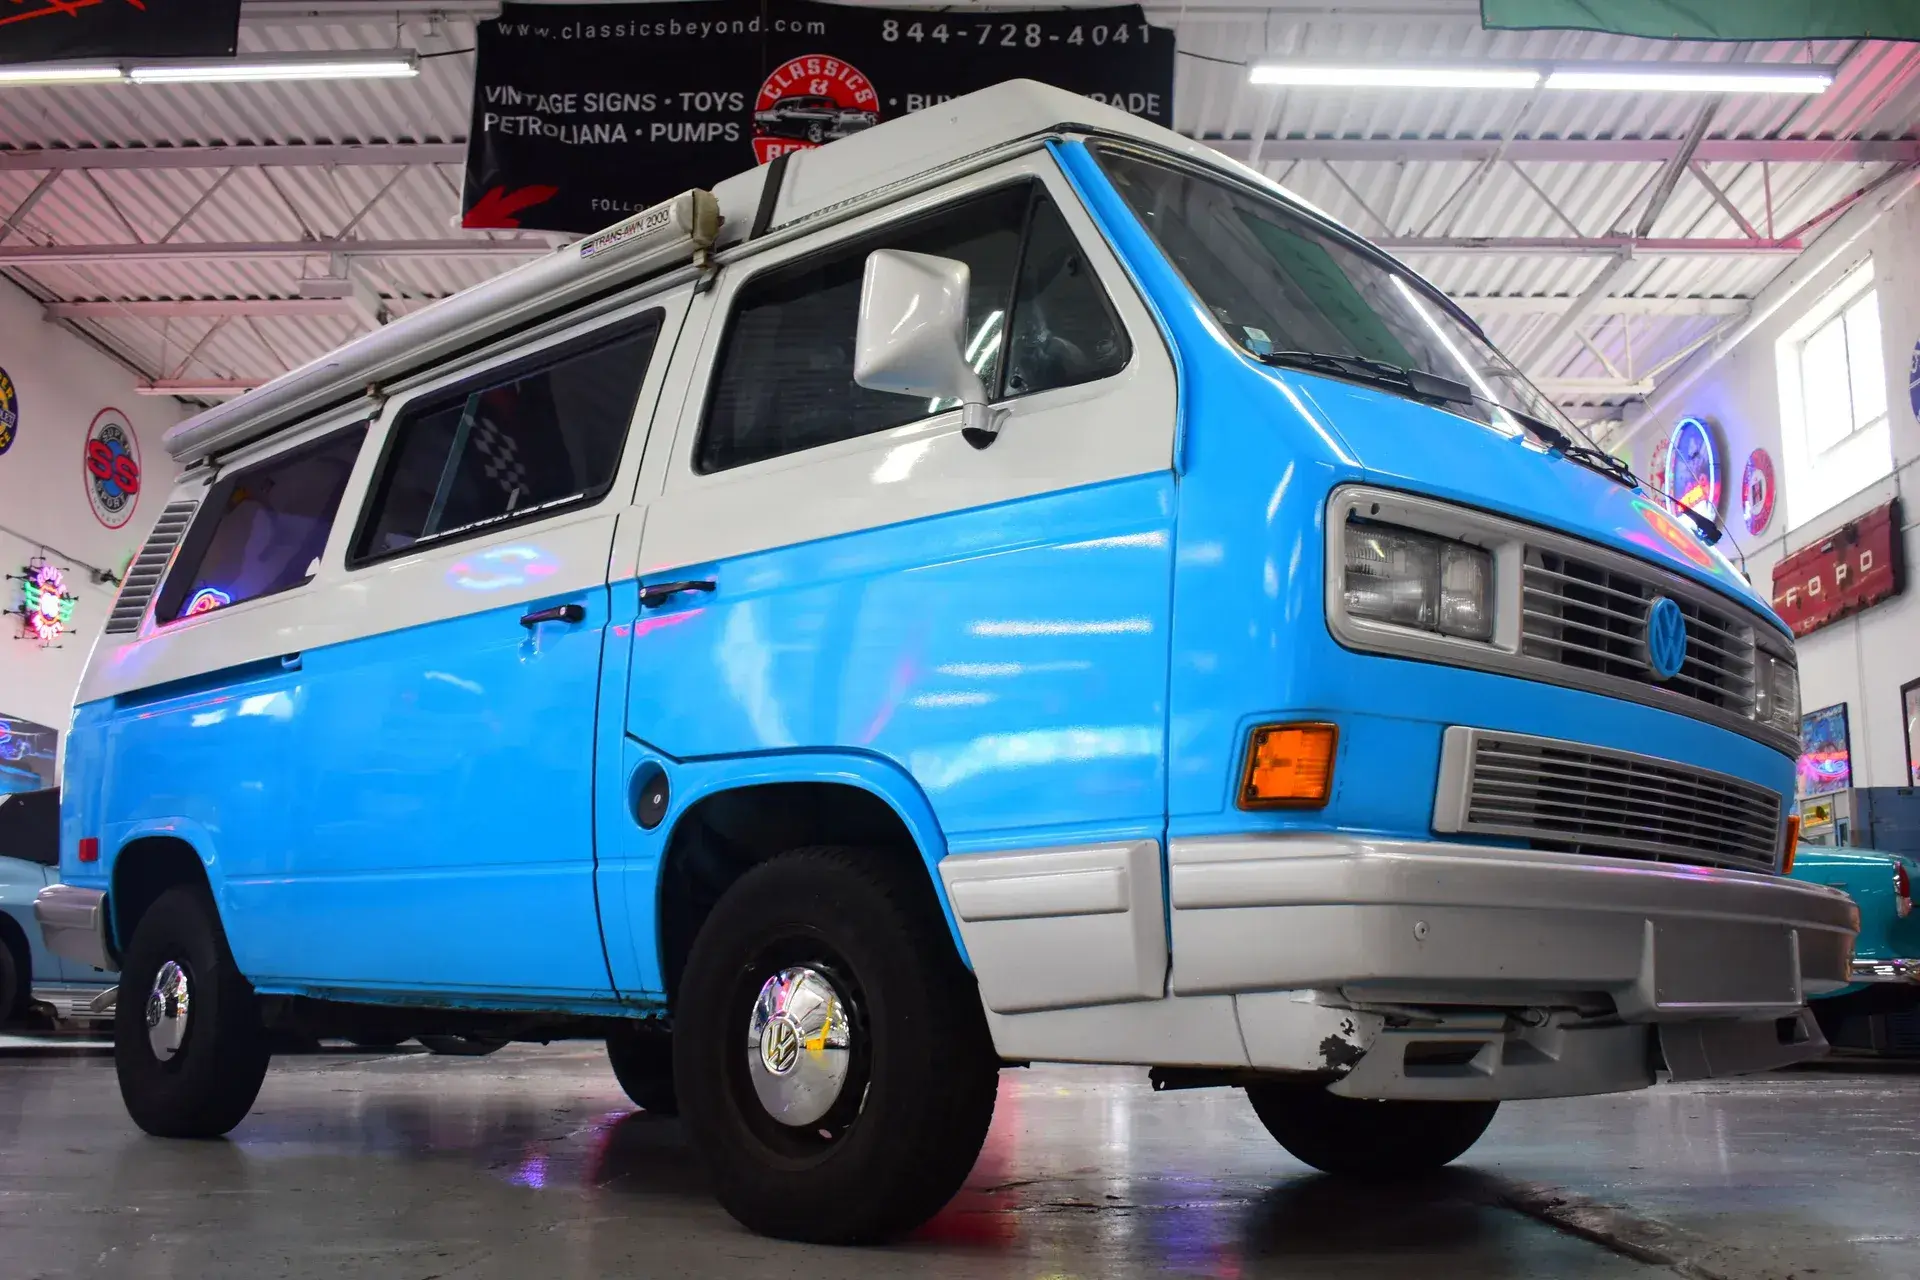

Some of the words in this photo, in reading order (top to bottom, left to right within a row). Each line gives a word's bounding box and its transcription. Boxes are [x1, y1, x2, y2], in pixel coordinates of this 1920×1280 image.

[498, 17, 826, 41] www.classicsbeyond.com
[882, 19, 1151, 47] 844-728-4041
[764, 58, 874, 104] CLASSICS
[808, 78, 829, 96] &
[485, 85, 577, 115] VINTAGE
[583, 92, 657, 113] SIGNS
[678, 91, 744, 112] TOYS
[484, 112, 628, 144] PETROLIANA
[650, 123, 740, 143] PUMPS
[590, 198, 651, 213] FOLLO
[645, 209, 669, 229] 2000
[87, 439, 139, 495] SS
